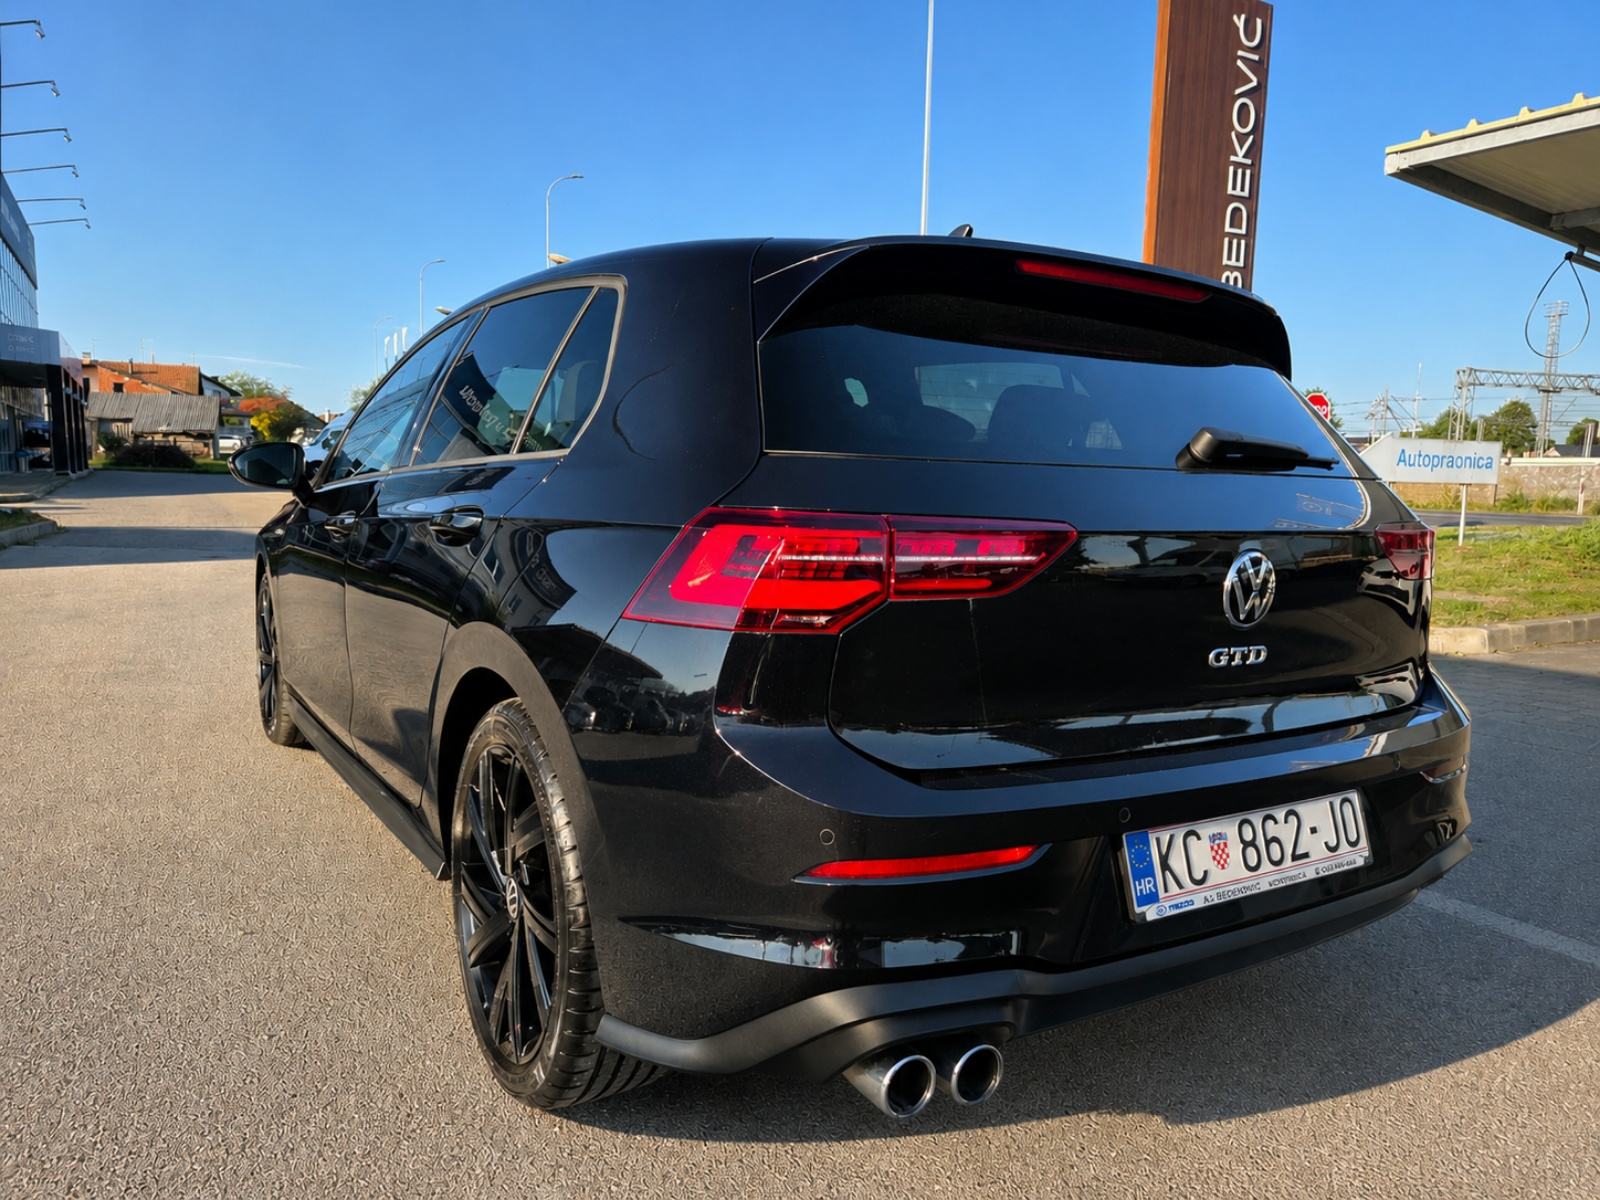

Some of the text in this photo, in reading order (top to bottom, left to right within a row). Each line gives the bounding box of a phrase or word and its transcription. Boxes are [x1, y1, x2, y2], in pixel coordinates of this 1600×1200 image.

[1397, 448, 1494, 472] Autopraonica
[1208, 645, 1268, 668] GTD
[1155, 828, 1209, 893] KC
[1135, 878, 1157, 897] HR
